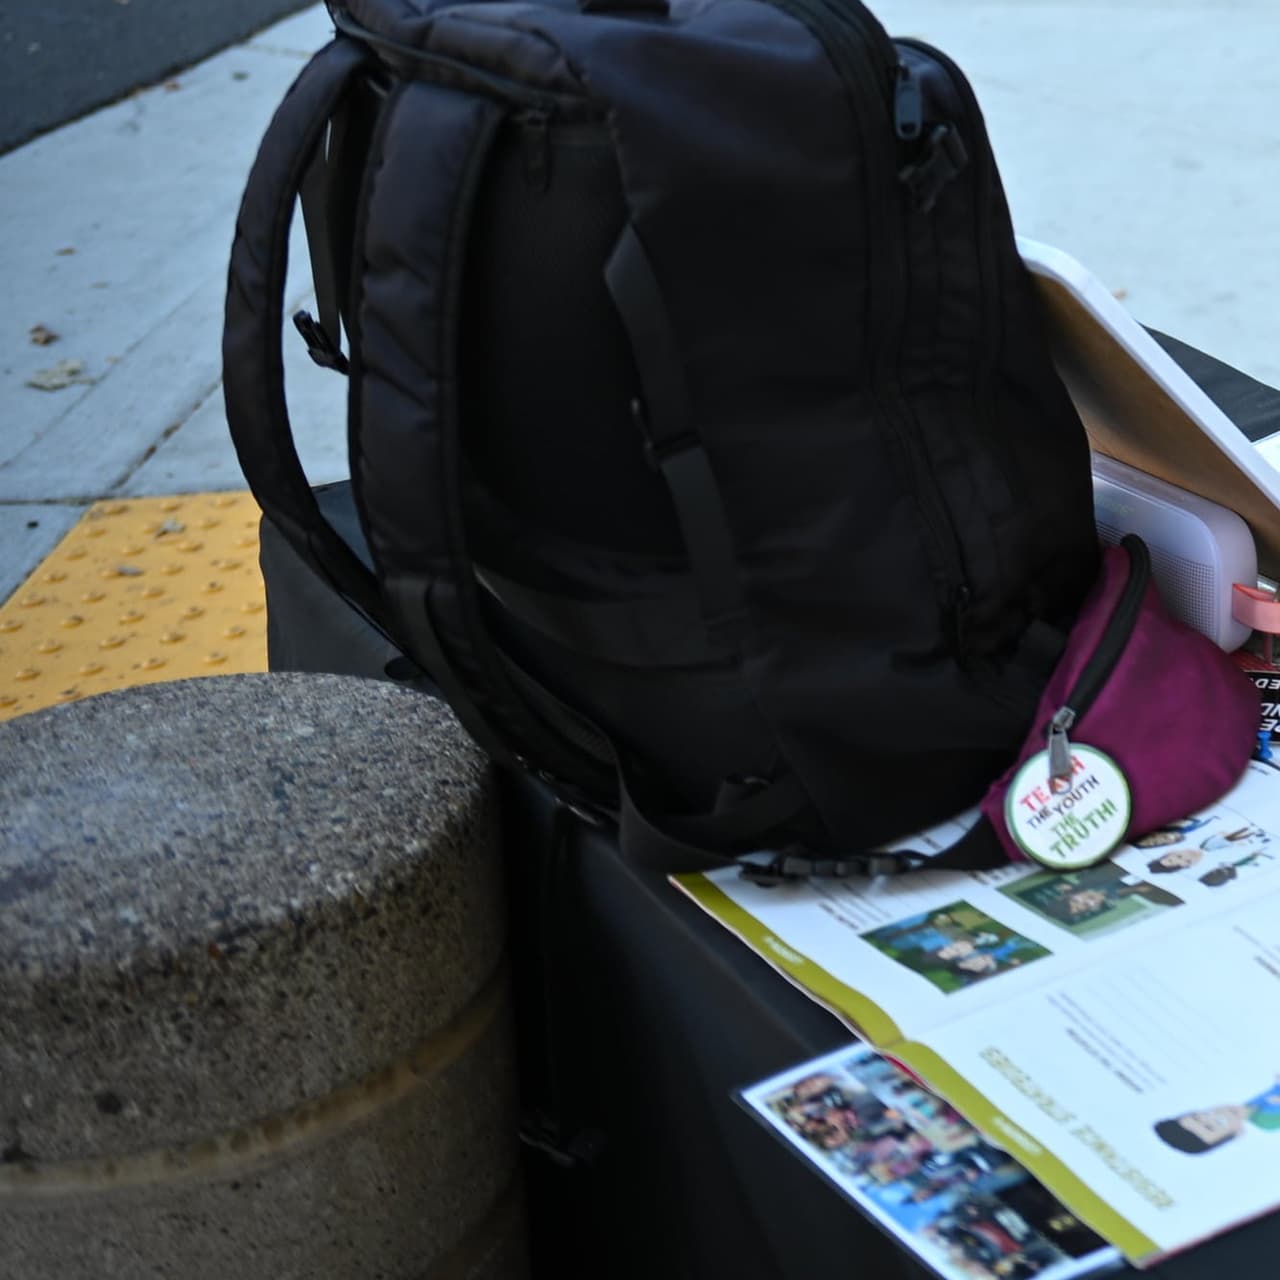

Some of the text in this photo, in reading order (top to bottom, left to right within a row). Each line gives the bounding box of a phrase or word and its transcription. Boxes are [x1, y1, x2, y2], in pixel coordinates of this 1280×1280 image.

[1026, 774, 1100, 829] THE YOUTH
[1049, 798, 1118, 859] TRUTH!
[1050, 811, 1077, 837] THE
